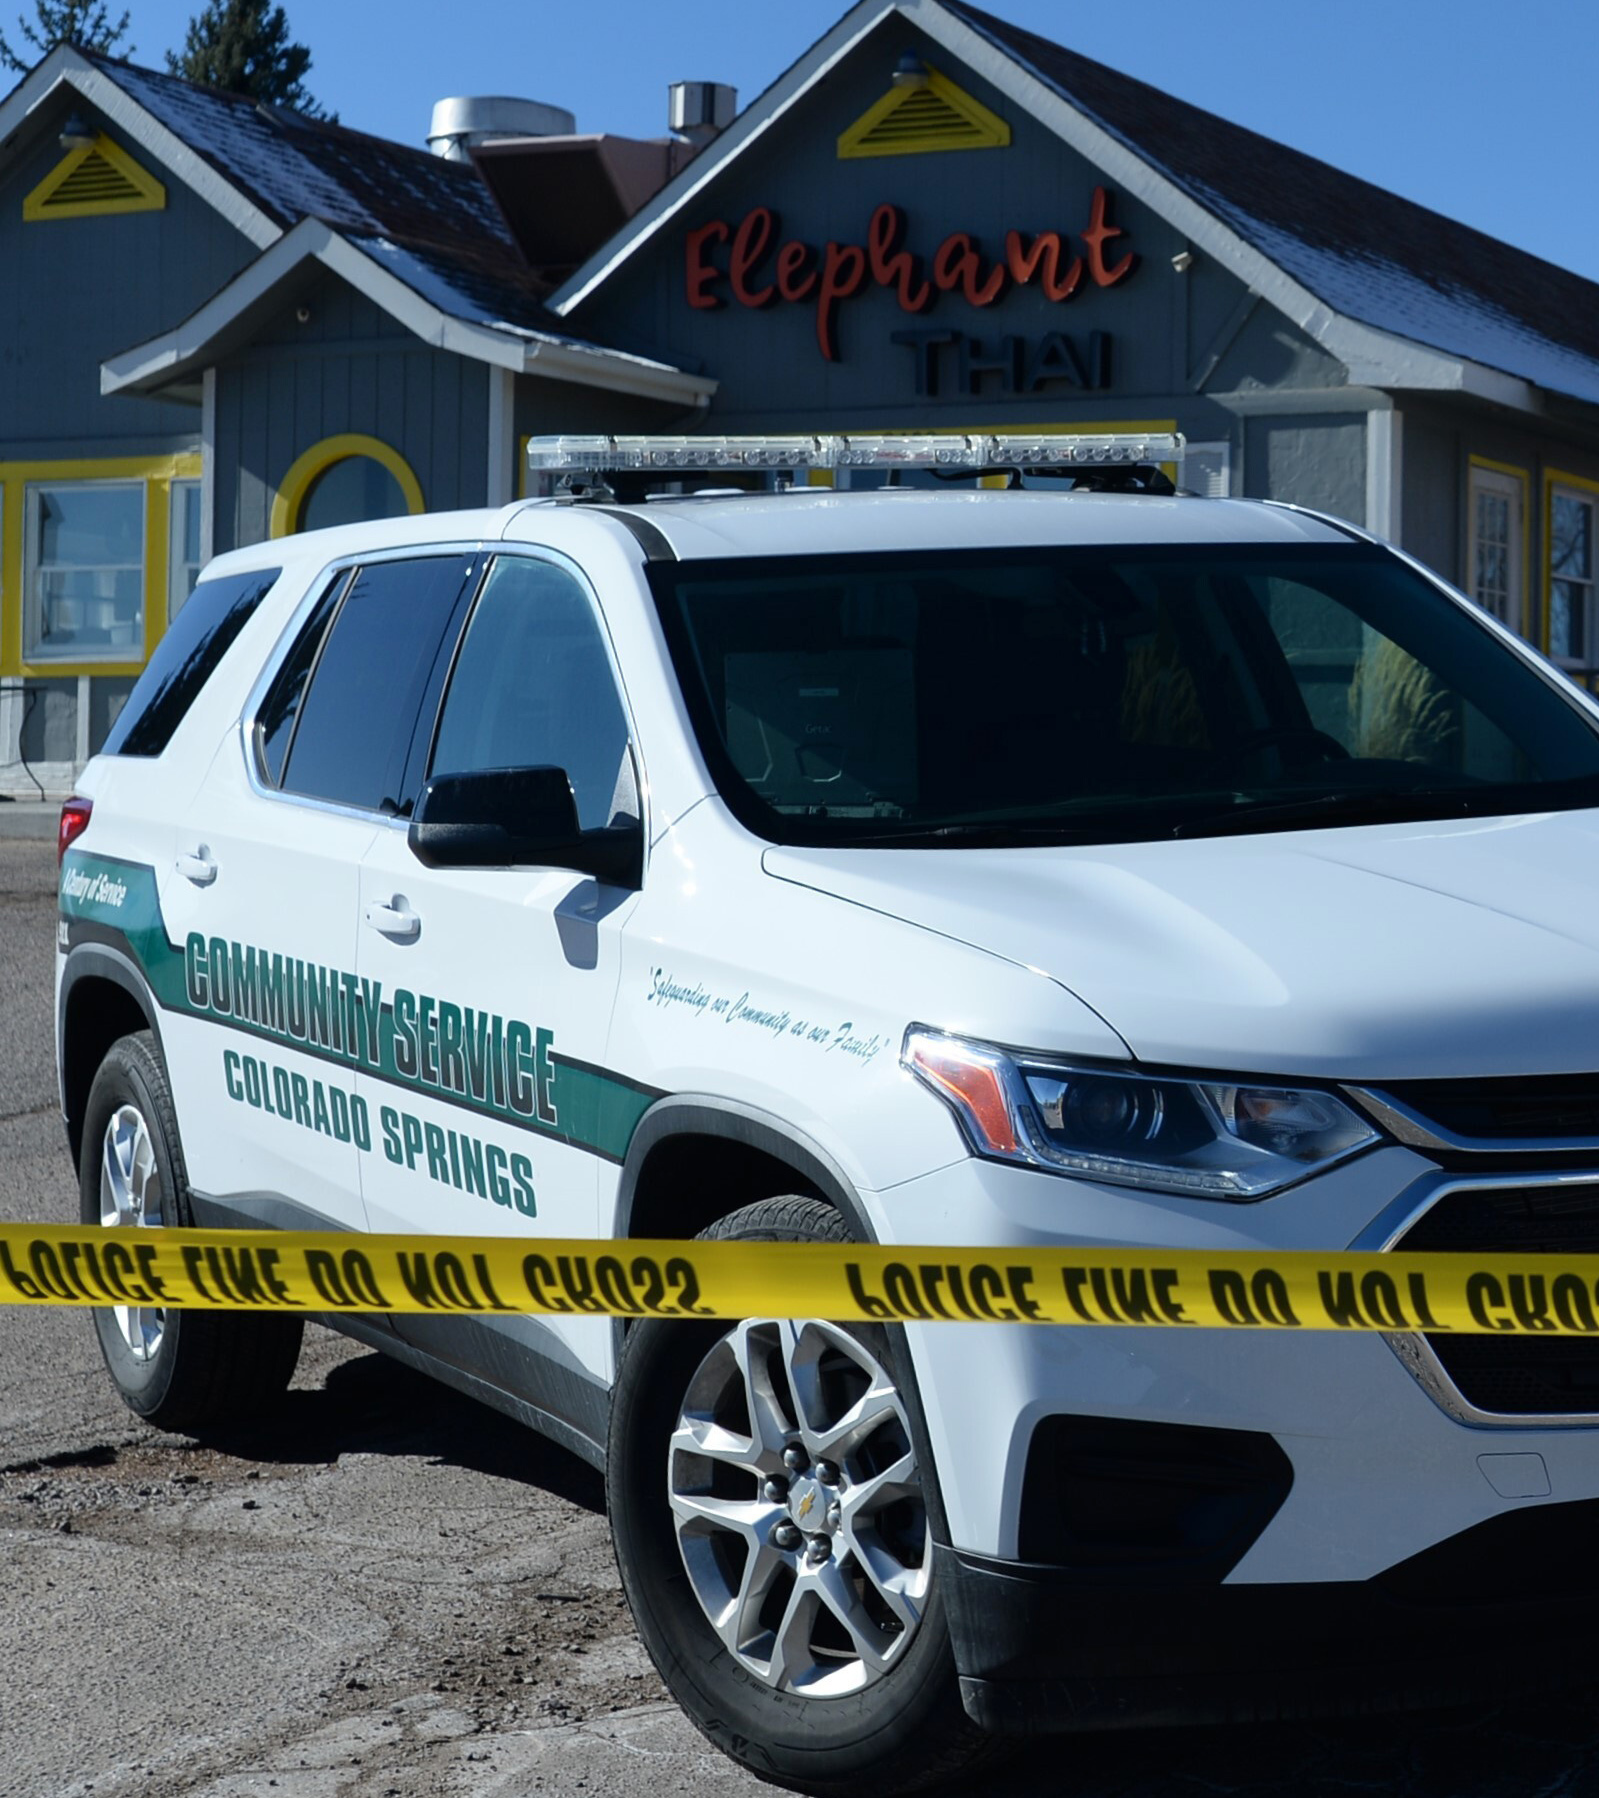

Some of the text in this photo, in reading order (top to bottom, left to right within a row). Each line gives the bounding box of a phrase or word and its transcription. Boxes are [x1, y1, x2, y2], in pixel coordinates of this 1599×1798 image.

[685, 185, 1135, 362] Elephant
[891, 329, 1112, 397] THAI
[69, 868, 92, 905] Century
[87, 872, 104, 901] of
[95, 873, 127, 907] Service
[185, 931, 558, 1127] COMMUNITY SERVICE
[711, 996, 730, 1014] our
[725, 992, 791, 1038] Community
[790, 1020, 809, 1036] as
[807, 1025, 830, 1043] our
[222, 1049, 538, 1219] COLORADO SPRINGS
